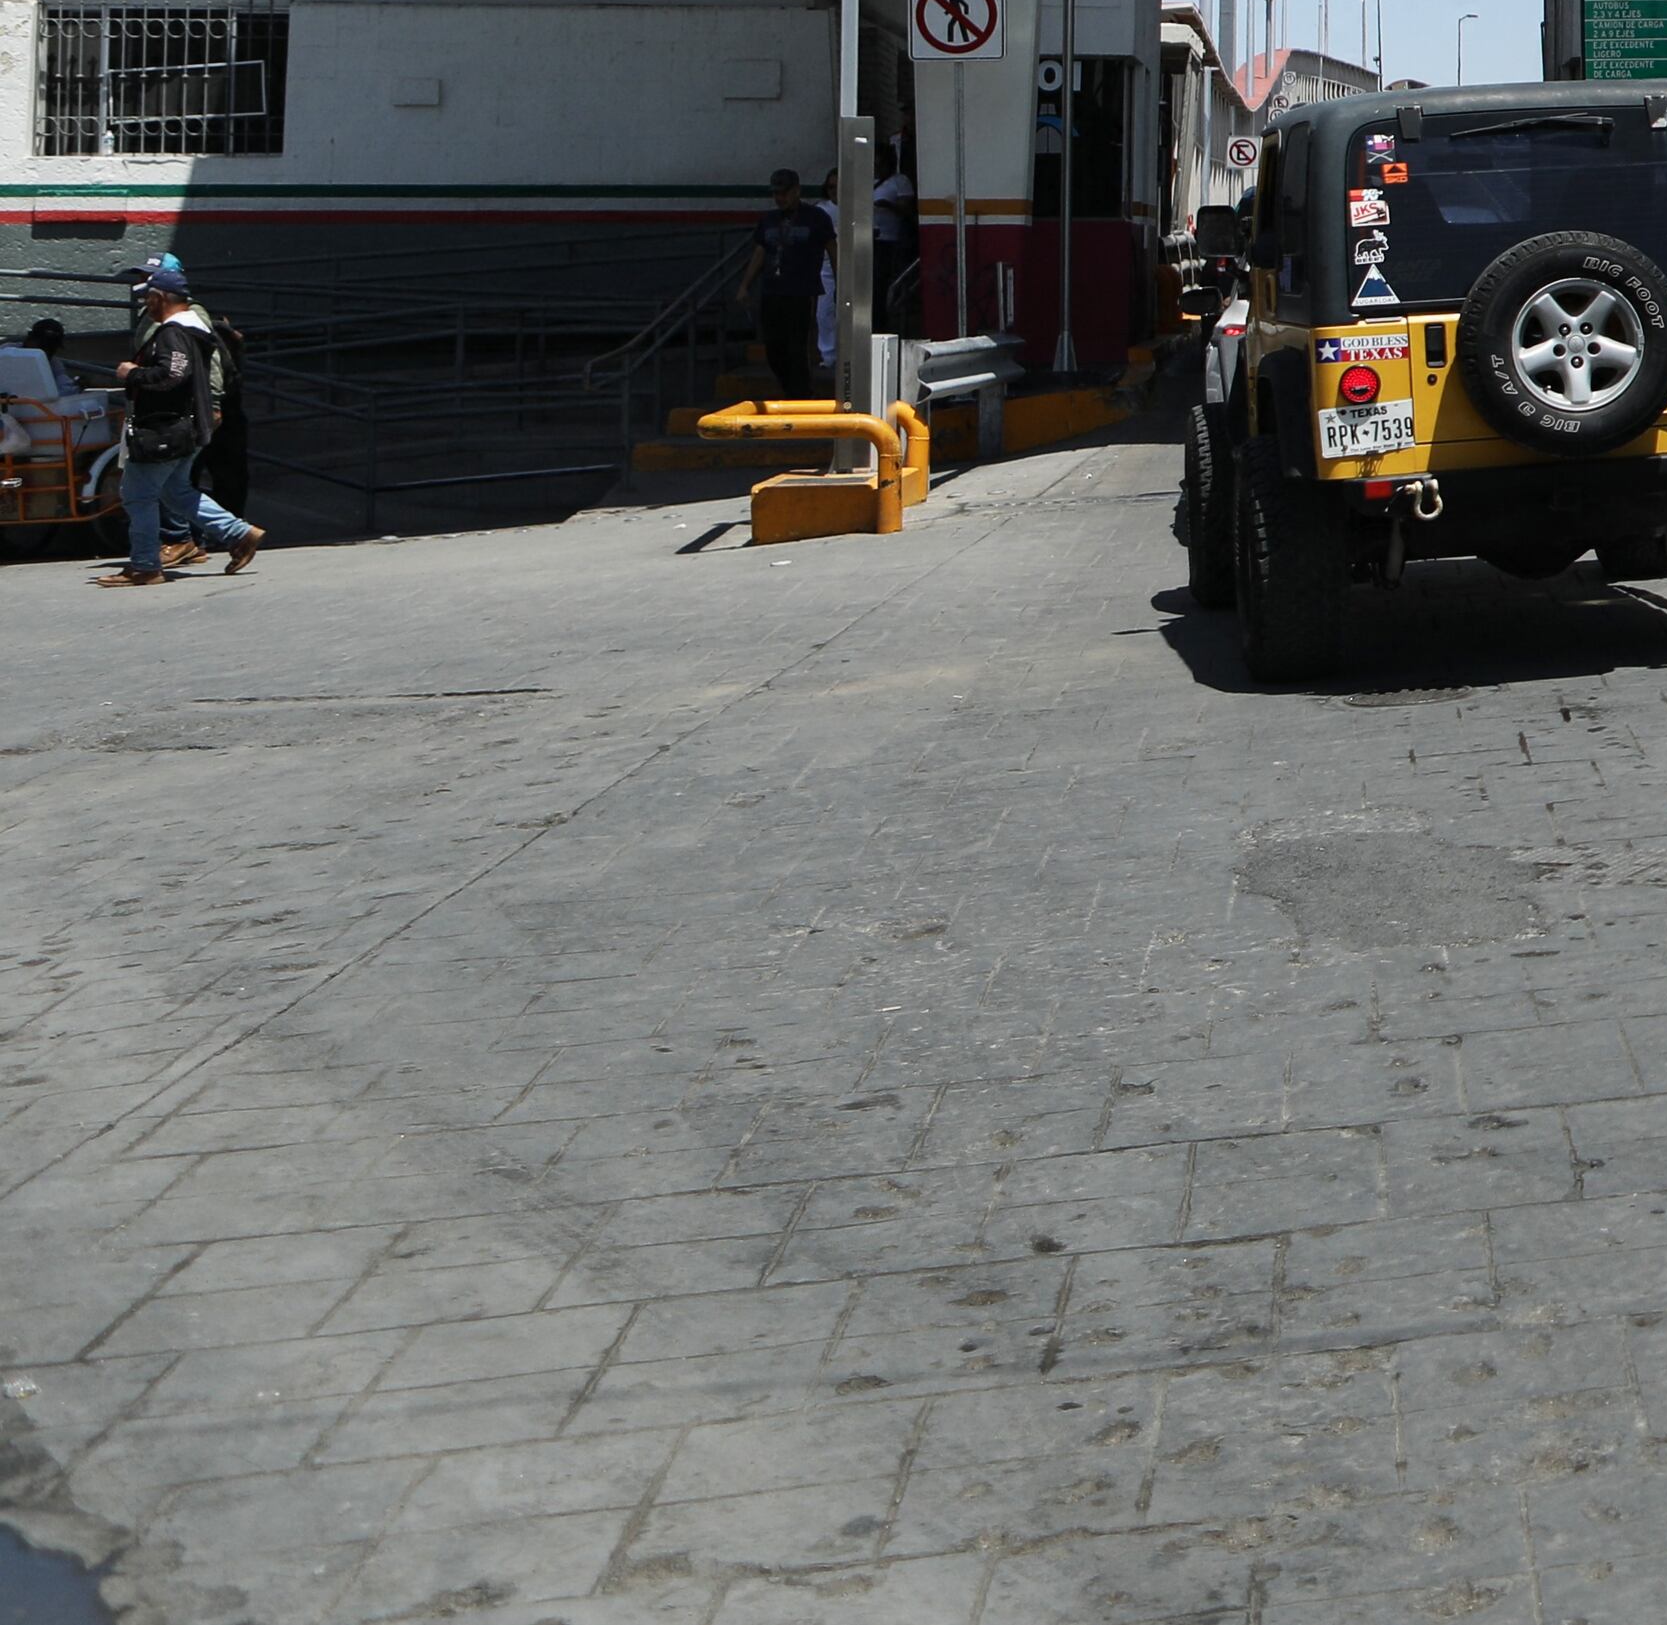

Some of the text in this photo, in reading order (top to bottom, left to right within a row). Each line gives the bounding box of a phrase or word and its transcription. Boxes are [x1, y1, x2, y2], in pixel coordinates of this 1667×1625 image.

[1593, 1, 1629, 9] AUTOBUS
[1609, 41, 1654, 49] EXCEDENTE
[1593, 50, 1622, 58] LIGERO
[1609, 61, 1654, 69] EXCEDENTE
[1605, 70, 1632, 78] CARGA
[1353, 203, 1378, 218] JKS
[1582, 256, 1665, 329] BIG FOOT
[1342, 335, 1408, 348] GOD BLESS
[1347, 347, 1403, 361] TEXAS
[1350, 406, 1387, 418] TEXAS
[1540, 414, 1581, 433] BIG
